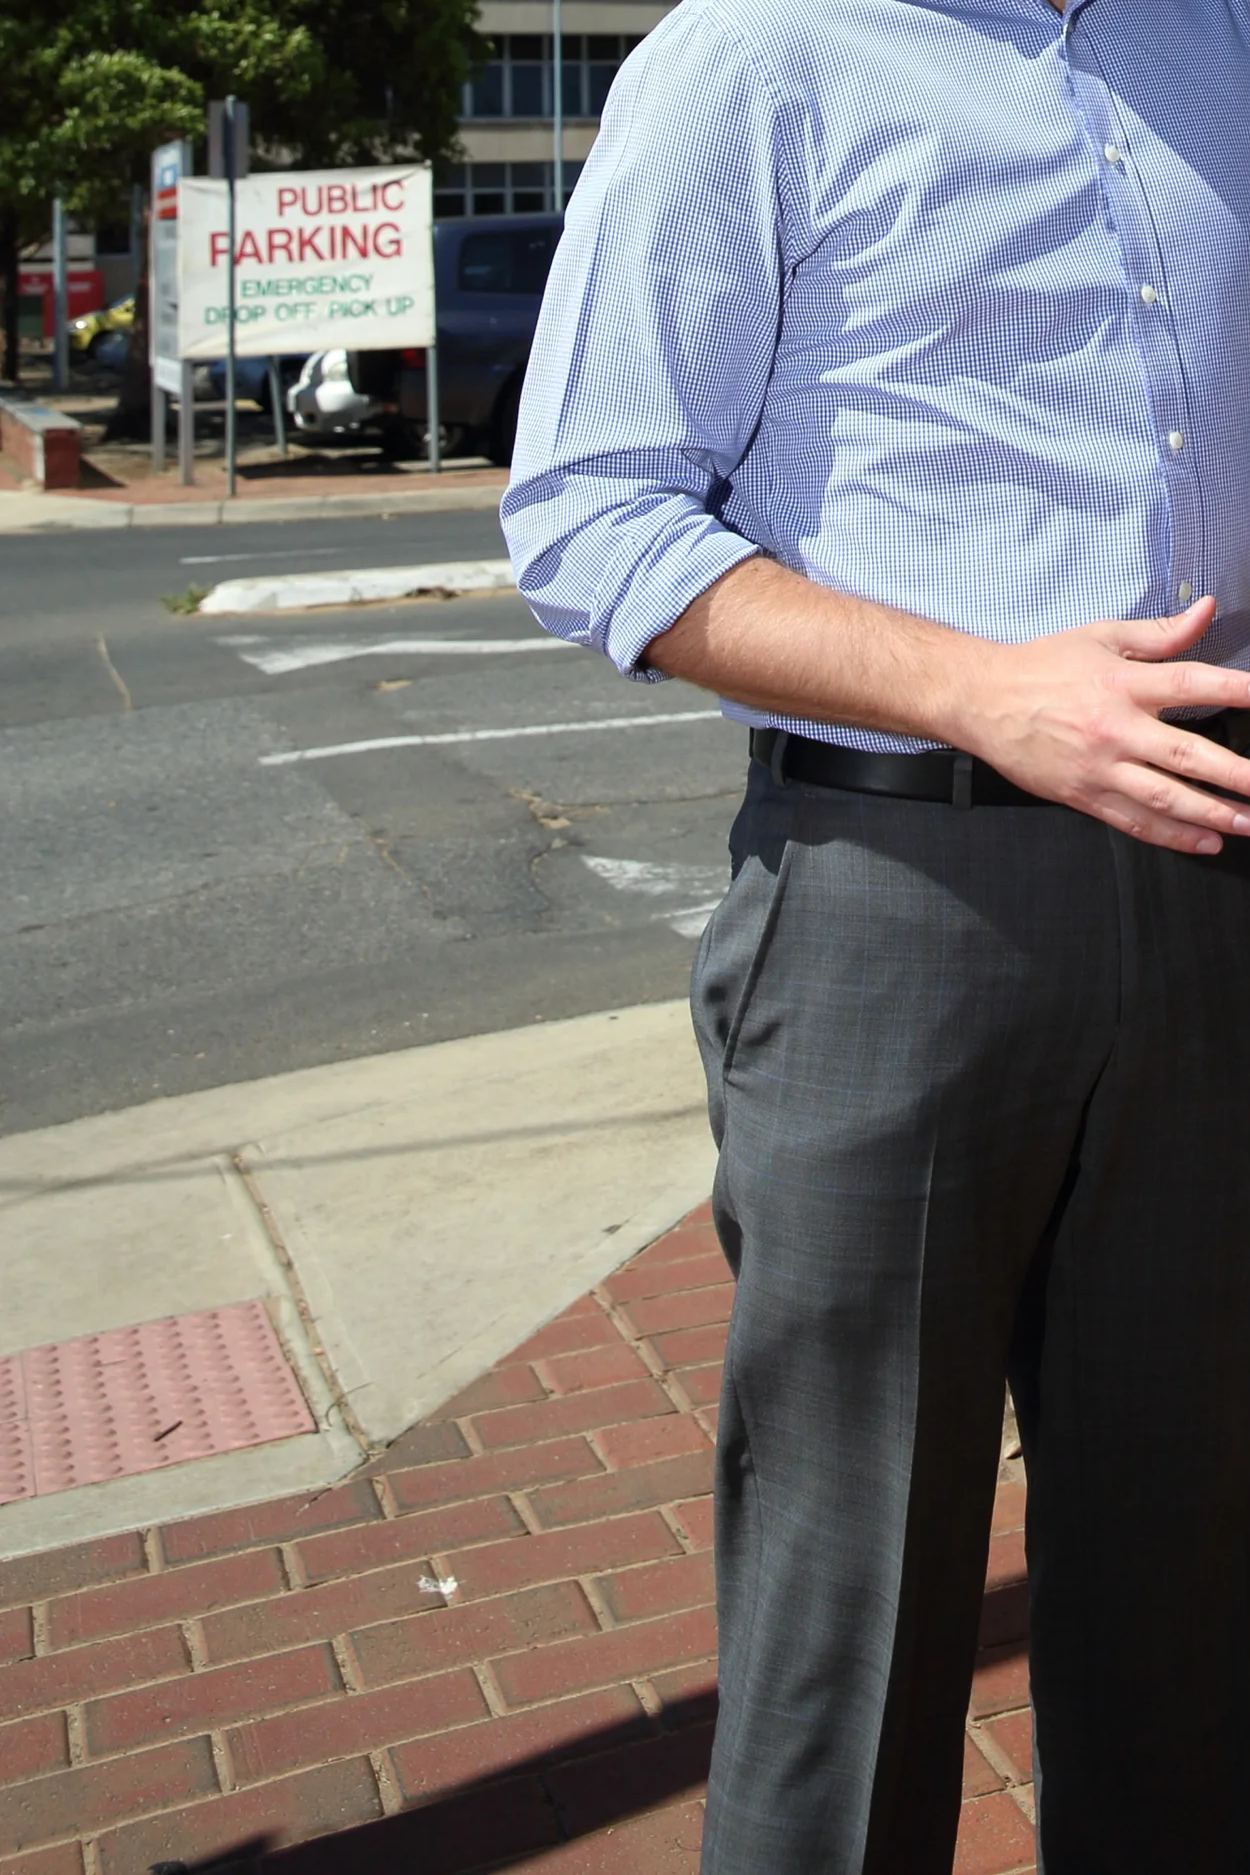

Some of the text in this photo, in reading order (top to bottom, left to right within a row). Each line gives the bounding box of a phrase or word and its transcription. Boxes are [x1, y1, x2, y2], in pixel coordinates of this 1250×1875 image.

[277, 180, 405, 217] PUBLIC
[209, 222, 403, 267] PARKING
[240, 274, 374, 298] EMERGENCY
[275, 301, 316, 321] OFF
[328, 299, 377, 319] PICK
[386, 296, 415, 316] UP
